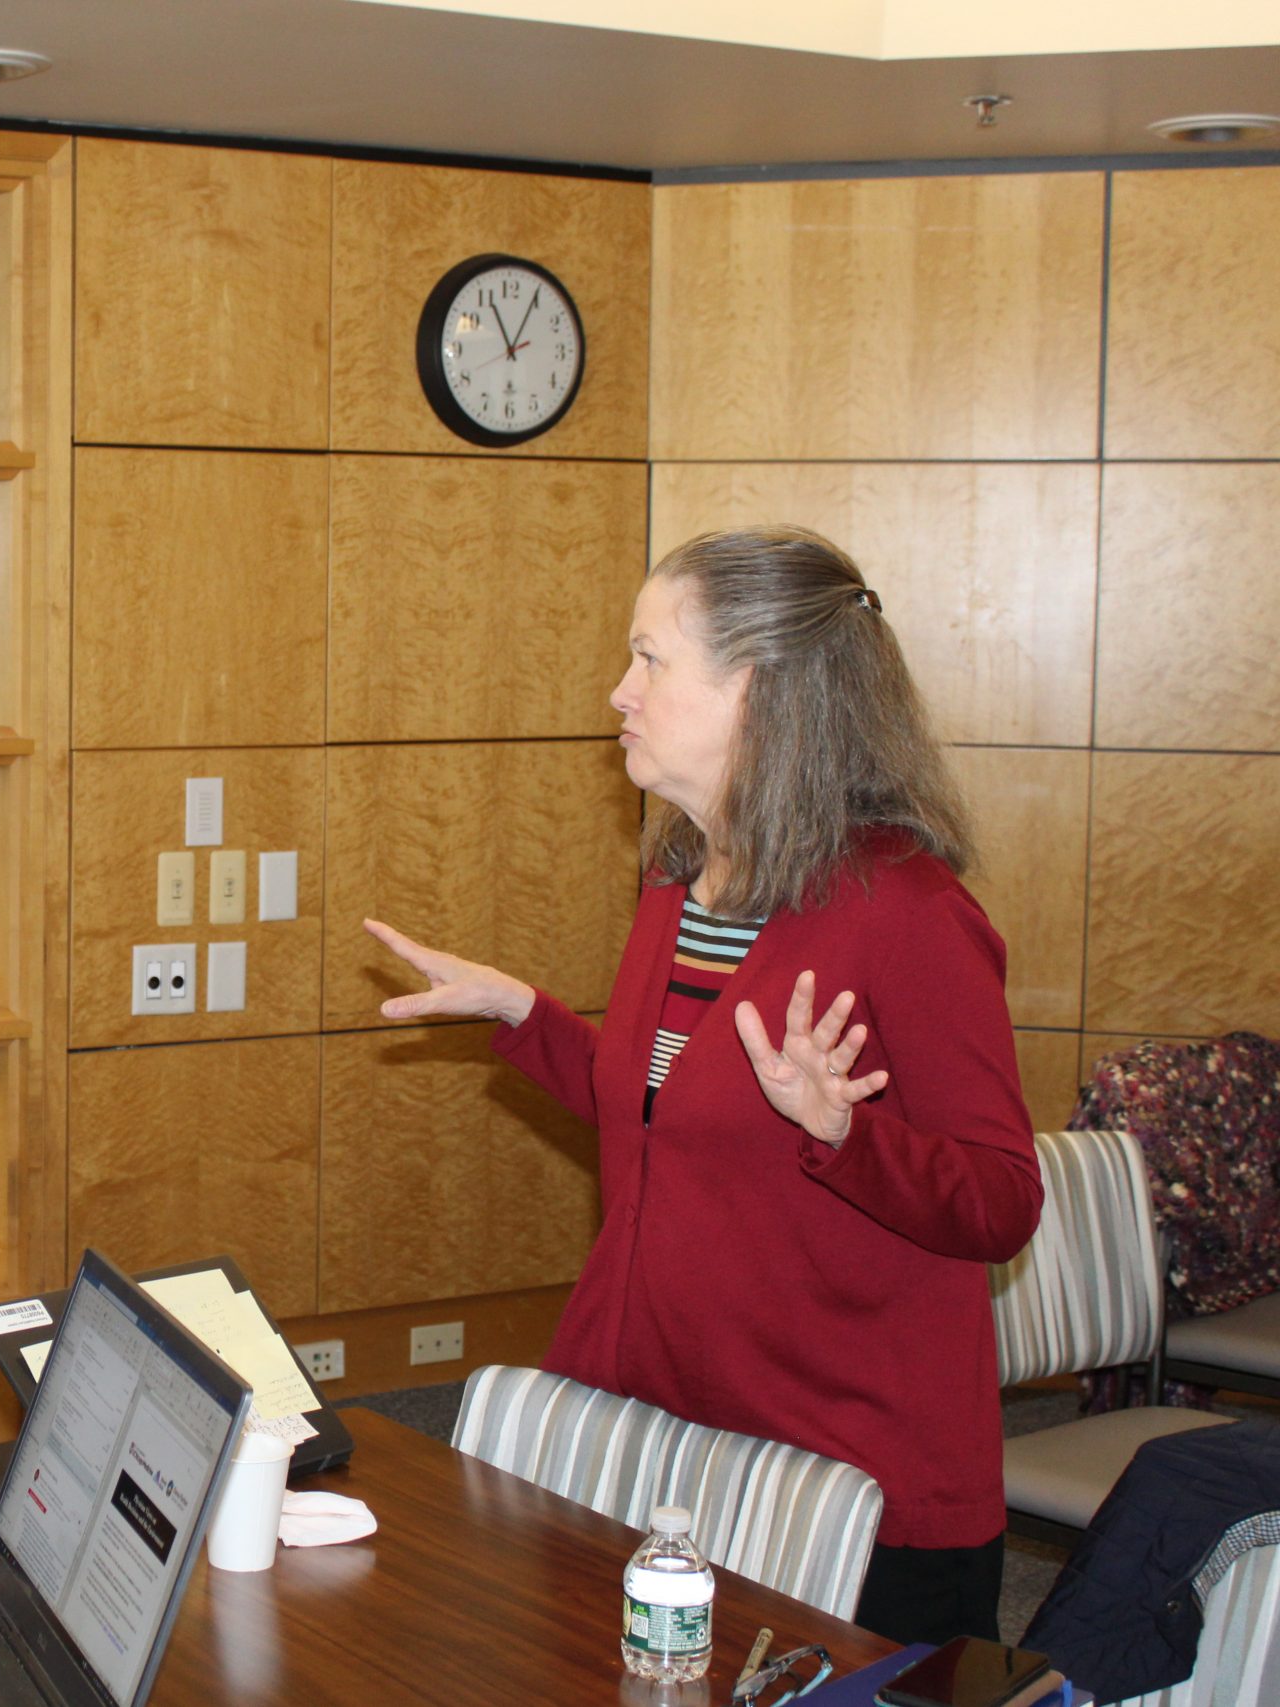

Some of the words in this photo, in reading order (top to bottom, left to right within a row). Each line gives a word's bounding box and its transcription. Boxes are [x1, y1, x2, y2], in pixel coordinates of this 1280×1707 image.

[478, 289, 494, 307] 11
[502, 280, 519, 299] 12
[462, 312, 480, 330] 10
[550, 315, 560, 333] 2
[451, 341, 462, 359] 9
[555, 343, 565, 361] 3
[460, 370, 471, 388] 8
[548, 371, 557, 389] 4
[481, 393, 489, 412] 7
[505, 401, 515, 419] 6
[529, 394, 538, 412] 5
